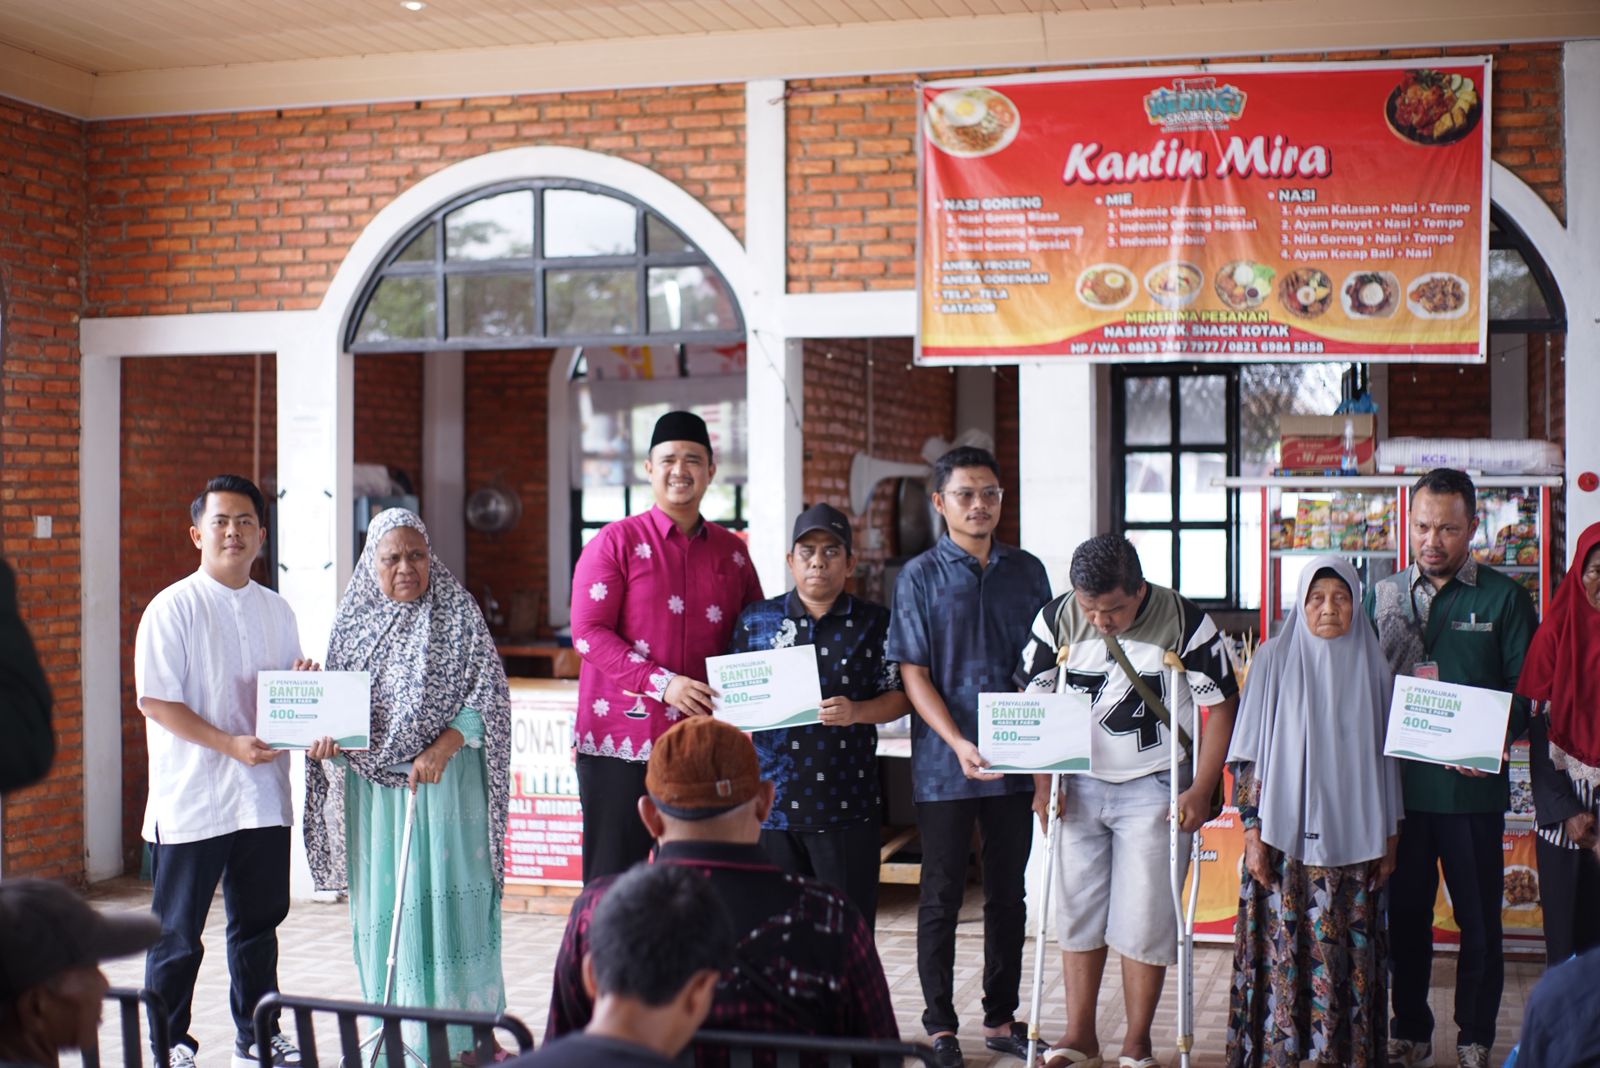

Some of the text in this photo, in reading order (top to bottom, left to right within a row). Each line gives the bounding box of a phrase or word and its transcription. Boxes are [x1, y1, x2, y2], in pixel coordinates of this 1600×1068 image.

[1063, 134, 1331, 183] Kantin Mira
[1105, 193, 1133, 206] MIE
[1279, 189, 1316, 202] NASI
[944, 196, 1043, 211] NASI GORENG
[1294, 204, 1329, 217] Ayam
[1331, 203, 1380, 215] Kalasan
[1391, 202, 1418, 214] Nasi
[1429, 202, 1471, 215] Tempe
[1294, 219, 1329, 232] Ayam
[1331, 219, 1373, 232] Penyet
[1384, 217, 1411, 229] Nasi
[1422, 217, 1464, 230] Tempe
[1320, 233, 1364, 247] Goreng
[1375, 231, 1402, 244] Nasi
[1413, 232, 1454, 245] Tempe
[1294, 248, 1328, 261] Ayam
[1331, 248, 1368, 261] Kecap
[1370, 246, 1394, 259] Bali
[1406, 246, 1432, 259] Nasi
[1201, 310, 1269, 322] PESANAN
[1103, 325, 1137, 338] NASI
[1191, 324, 1238, 337] SNACK
[1241, 324, 1290, 337] KOTAK
[720, 665, 773, 682] BANTUAN
[269, 686, 324, 697] BANTUAN
[724, 692, 749, 704] 400
[1405, 692, 1462, 712] BANTUAN
[269, 709, 295, 719] 400
[992, 708, 1046, 719] BANTUAN
[1402, 716, 1429, 730] 400
[513, 717, 567, 755] ONAT
[992, 731, 1018, 742] 400
